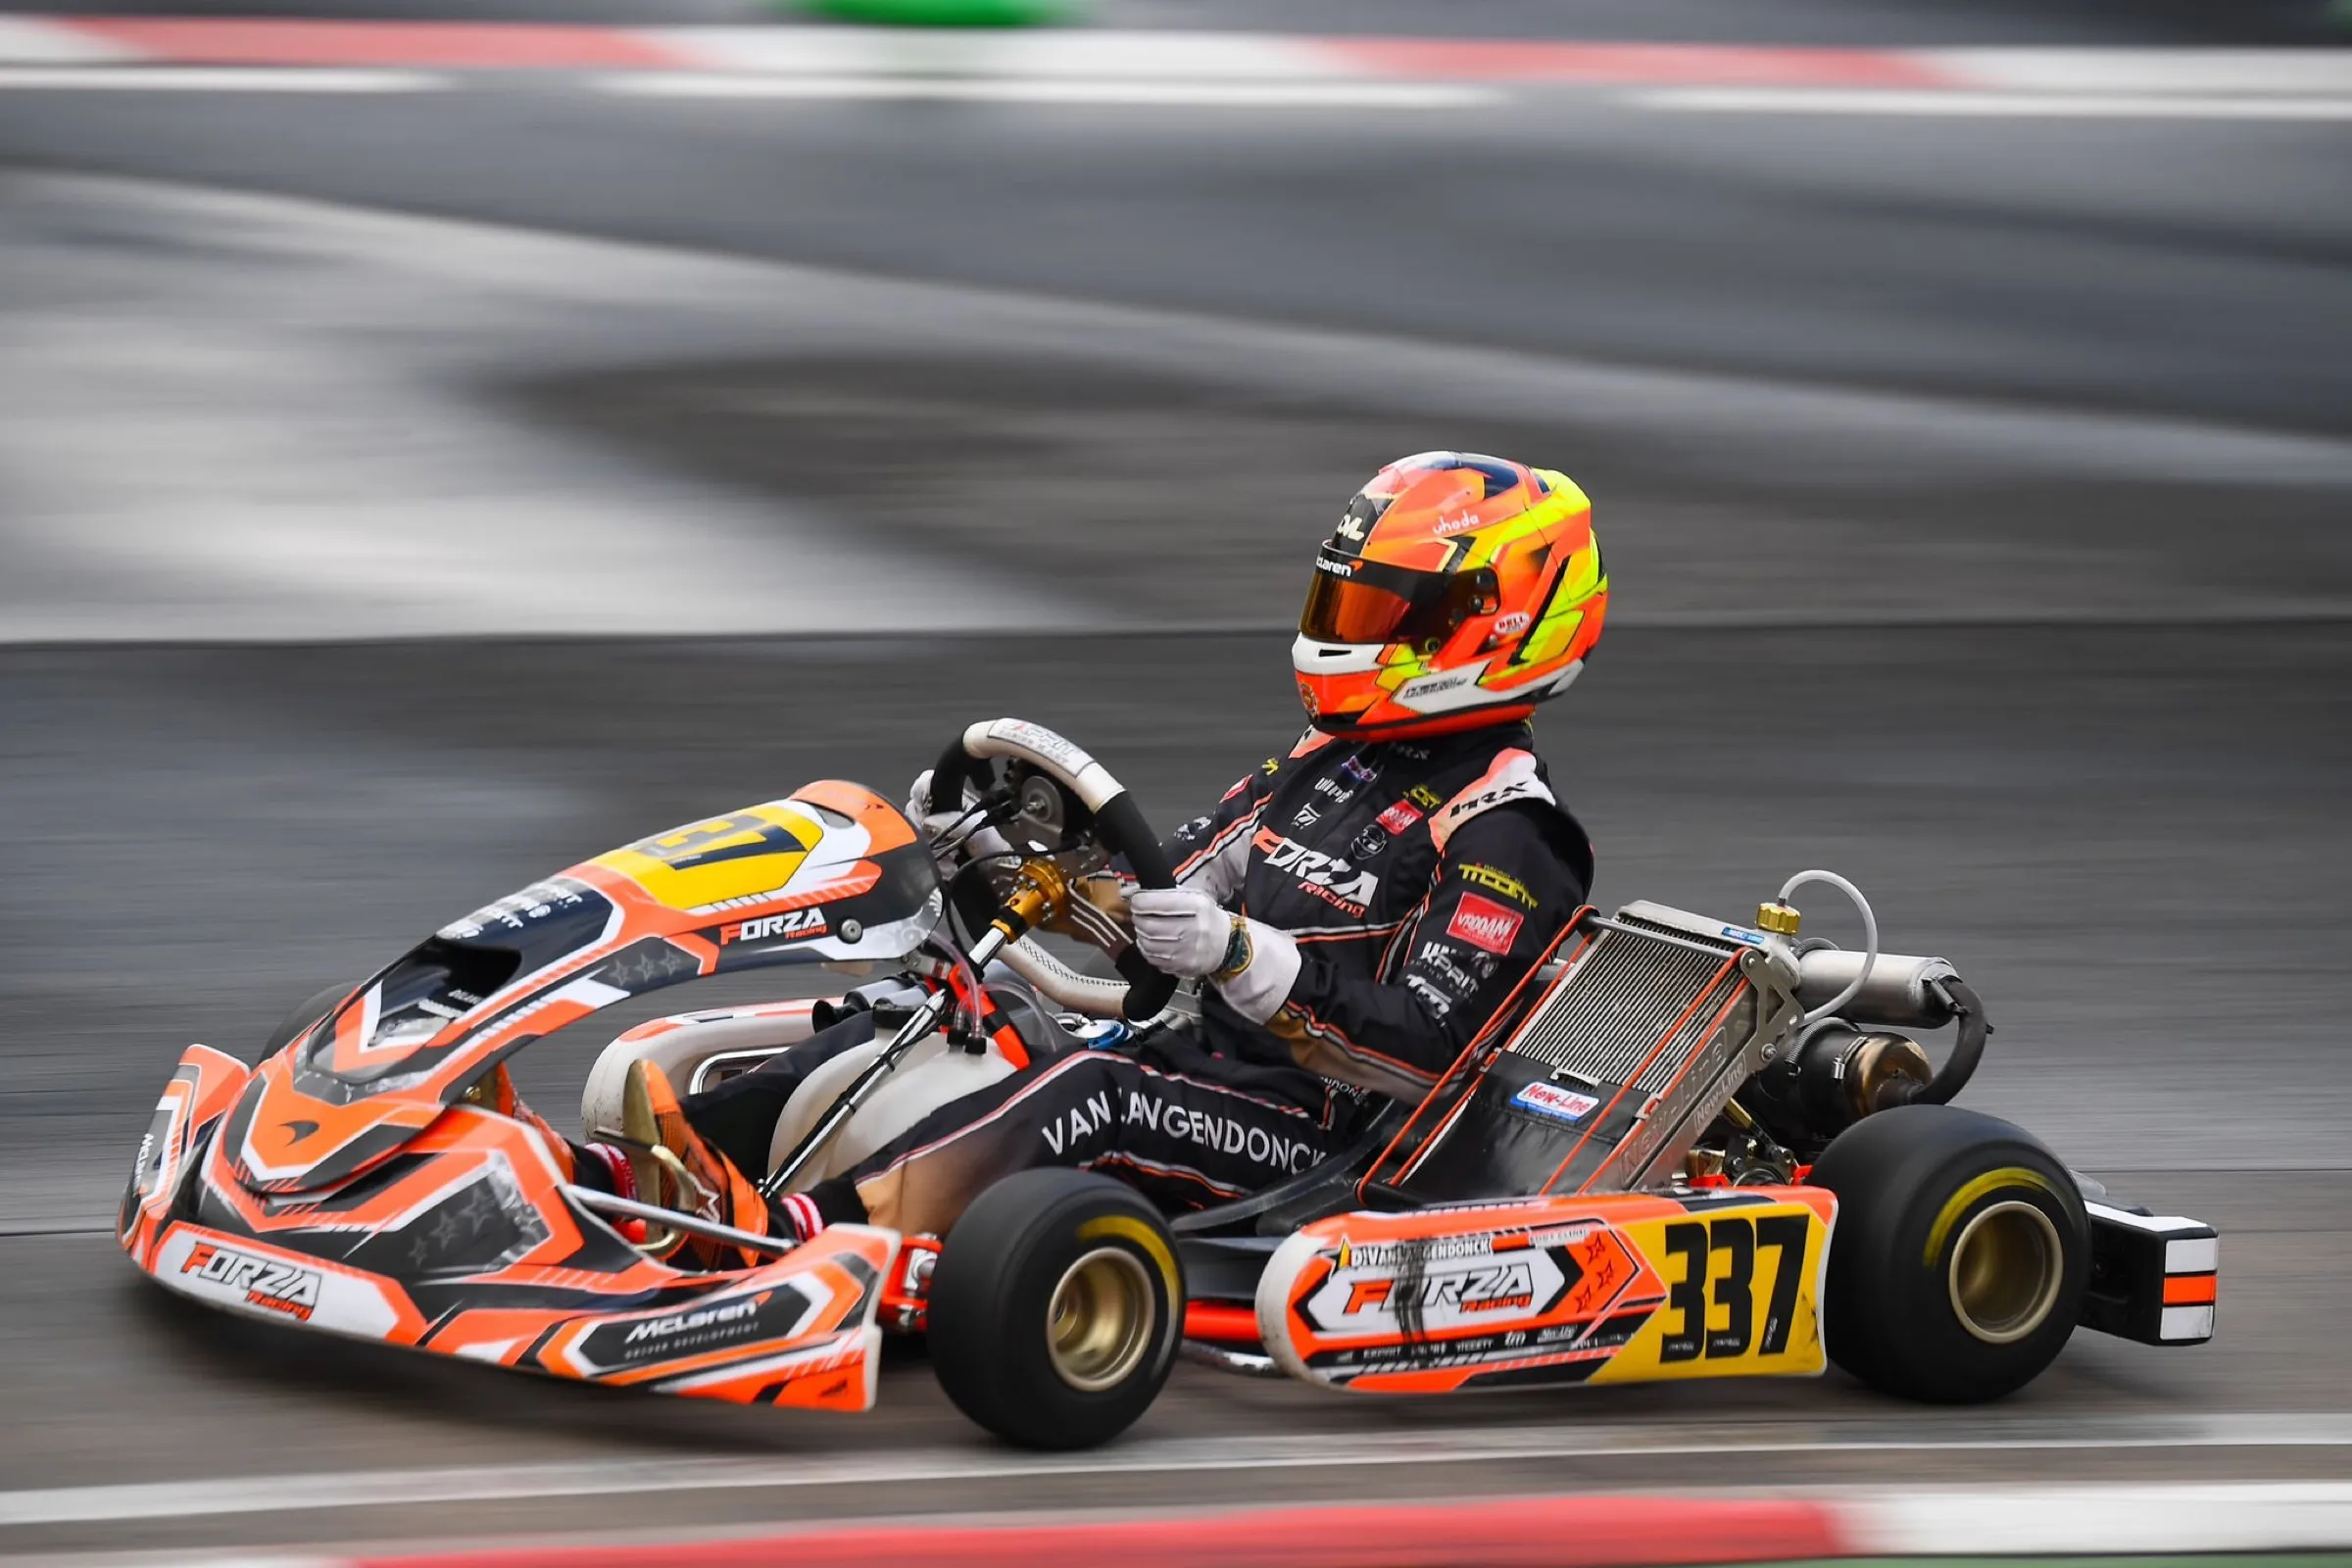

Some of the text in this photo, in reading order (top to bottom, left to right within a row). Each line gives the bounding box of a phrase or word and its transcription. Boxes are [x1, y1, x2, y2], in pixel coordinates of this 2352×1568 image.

[1433, 510, 1479, 536] uhoda
[1251, 825, 1379, 906] FORZA
[719, 906, 826, 947] FORZA
[1042, 1091, 1111, 1155] VAN
[1522, 1084, 1591, 1111] New-Line
[180, 1241, 321, 1307] FORZA
[1659, 1214, 1810, 1364] 337
[624, 1300, 757, 1345] McLaren
